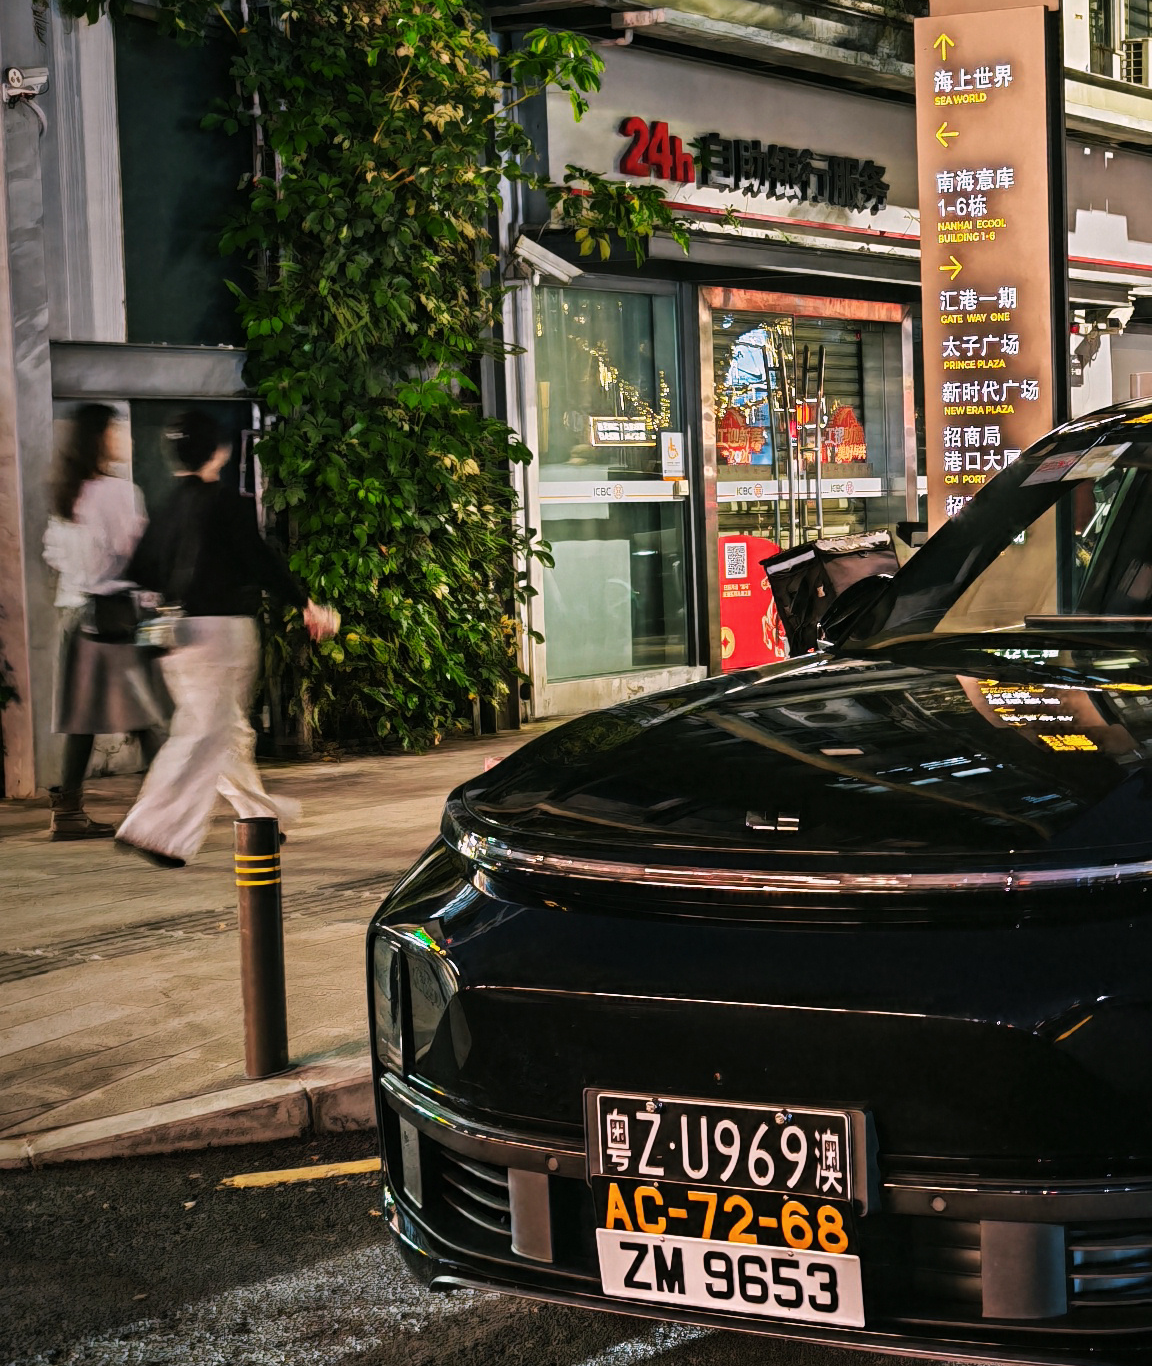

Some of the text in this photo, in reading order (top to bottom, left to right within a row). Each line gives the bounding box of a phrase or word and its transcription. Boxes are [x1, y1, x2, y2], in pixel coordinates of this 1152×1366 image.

[933, 64, 1013, 93] 海上世界
[934, 92, 987, 106] SEA WORLD
[935, 166, 1015, 194] 南海意库
[937, 194, 988, 218] 1-6栋
[938, 218, 1007, 232] NANHAI ECOOL
[938, 232, 980, 244] BUILDING
[939, 286, 1017, 311] 汇港一期
[940, 312, 1010, 324] GATE WAY ONE
[942, 334, 1020, 358] 太子广场
[943, 358, 1006, 370] PRINCE PLAZA
[942, 379, 1040, 403] 新时代广场
[944, 404, 1015, 416] NEW ERA PLAZA
[943, 425, 1001, 449] 招商局
[944, 473, 986, 485] CM PORT
[593, 487, 612, 496] ICBC
[736, 486, 753, 496] ICBC
[605, 1183, 849, 1254] AC-72-68
[619, 1241, 839, 1314] ZM 9653
